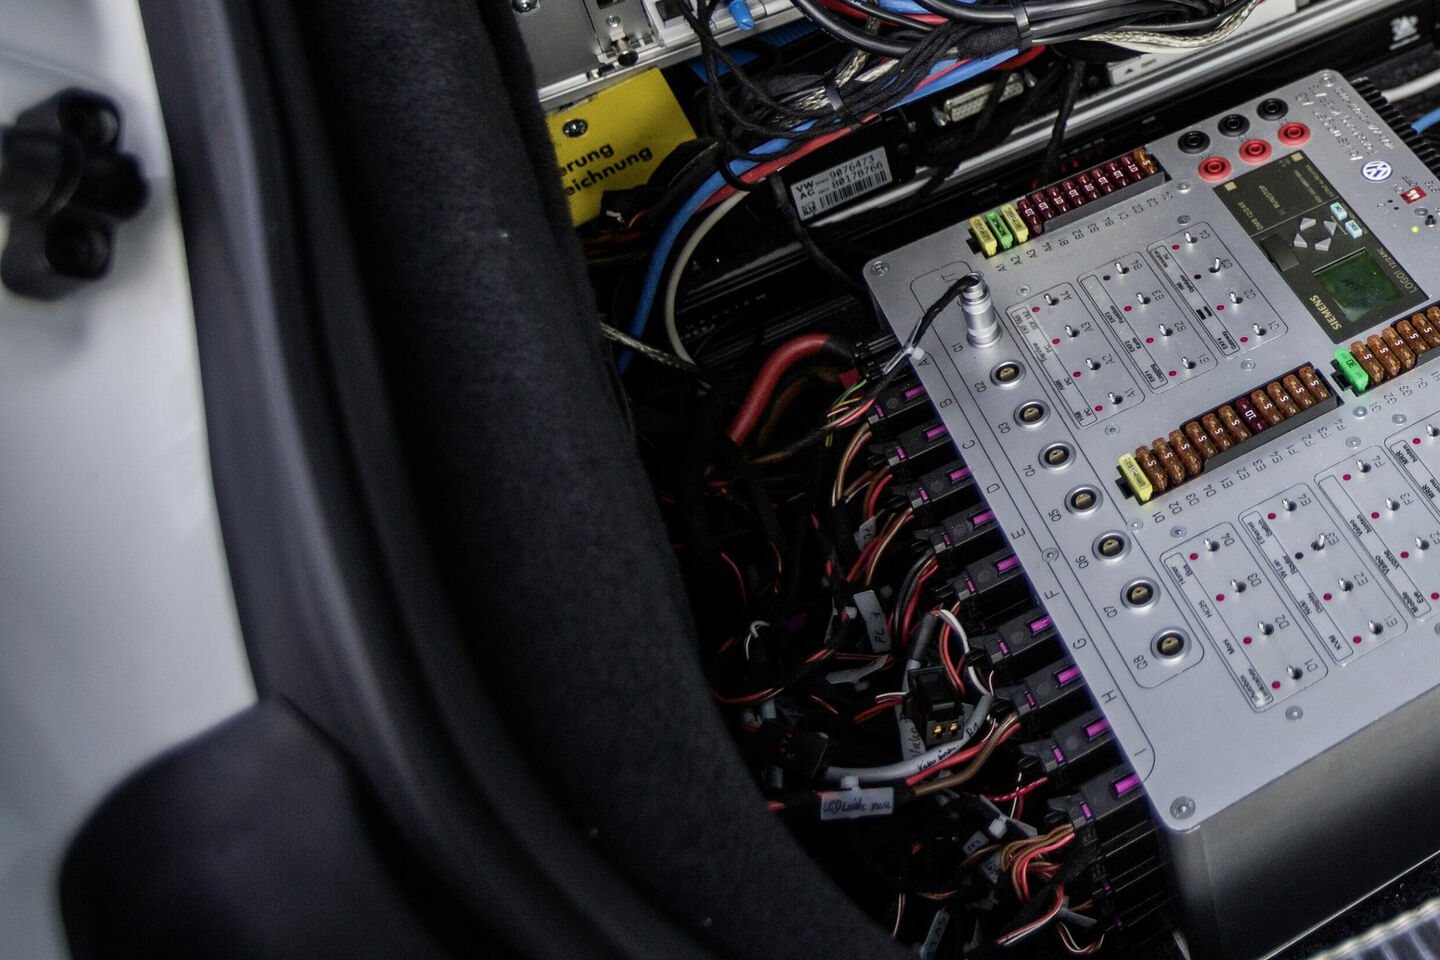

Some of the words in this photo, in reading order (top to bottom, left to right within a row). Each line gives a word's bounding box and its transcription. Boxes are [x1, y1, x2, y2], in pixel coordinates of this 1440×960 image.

[1308, 293, 1343, 330] SIEMENS
[950, 341, 964, 354] Q1
[972, 379, 988, 394] Q2
[996, 420, 1012, 435] Q3
[1268, 450, 1283, 463] E4
[1394, 450, 1409, 465] MRR
[1400, 443, 1419, 462] hinten
[1021, 462, 1037, 478] Q4
[1235, 466, 1250, 480] E2
[1251, 458, 1266, 472] E3
[1201, 483, 1217, 497] D4
[1220, 476, 1233, 488] E1
[1184, 491, 1200, 506] D3
[1296, 492, 1312, 506] E4
[1421, 483, 1436, 499] MRR
[1046, 506, 1063, 523] Q5
[1167, 500, 1183, 514] D2
[1151, 510, 1165, 523] D1
[1354, 513, 1373, 533] hinten
[1347, 518, 1364, 536] Valeo
[1219, 531, 1235, 547] D4
[1073, 553, 1091, 570] Q6
[1372, 554, 1391, 574] Valeo
[1245, 571, 1262, 587] D3
[1352, 571, 1369, 586] E2
[1399, 590, 1420, 613] Mobile
[1411, 589, 1425, 604] Eye
[1102, 601, 1120, 619] Q7
[1196, 599, 1213, 618] HC25
[1273, 613, 1290, 629] D2
[1131, 652, 1150, 671] Q8
[1303, 657, 1319, 673] D1
